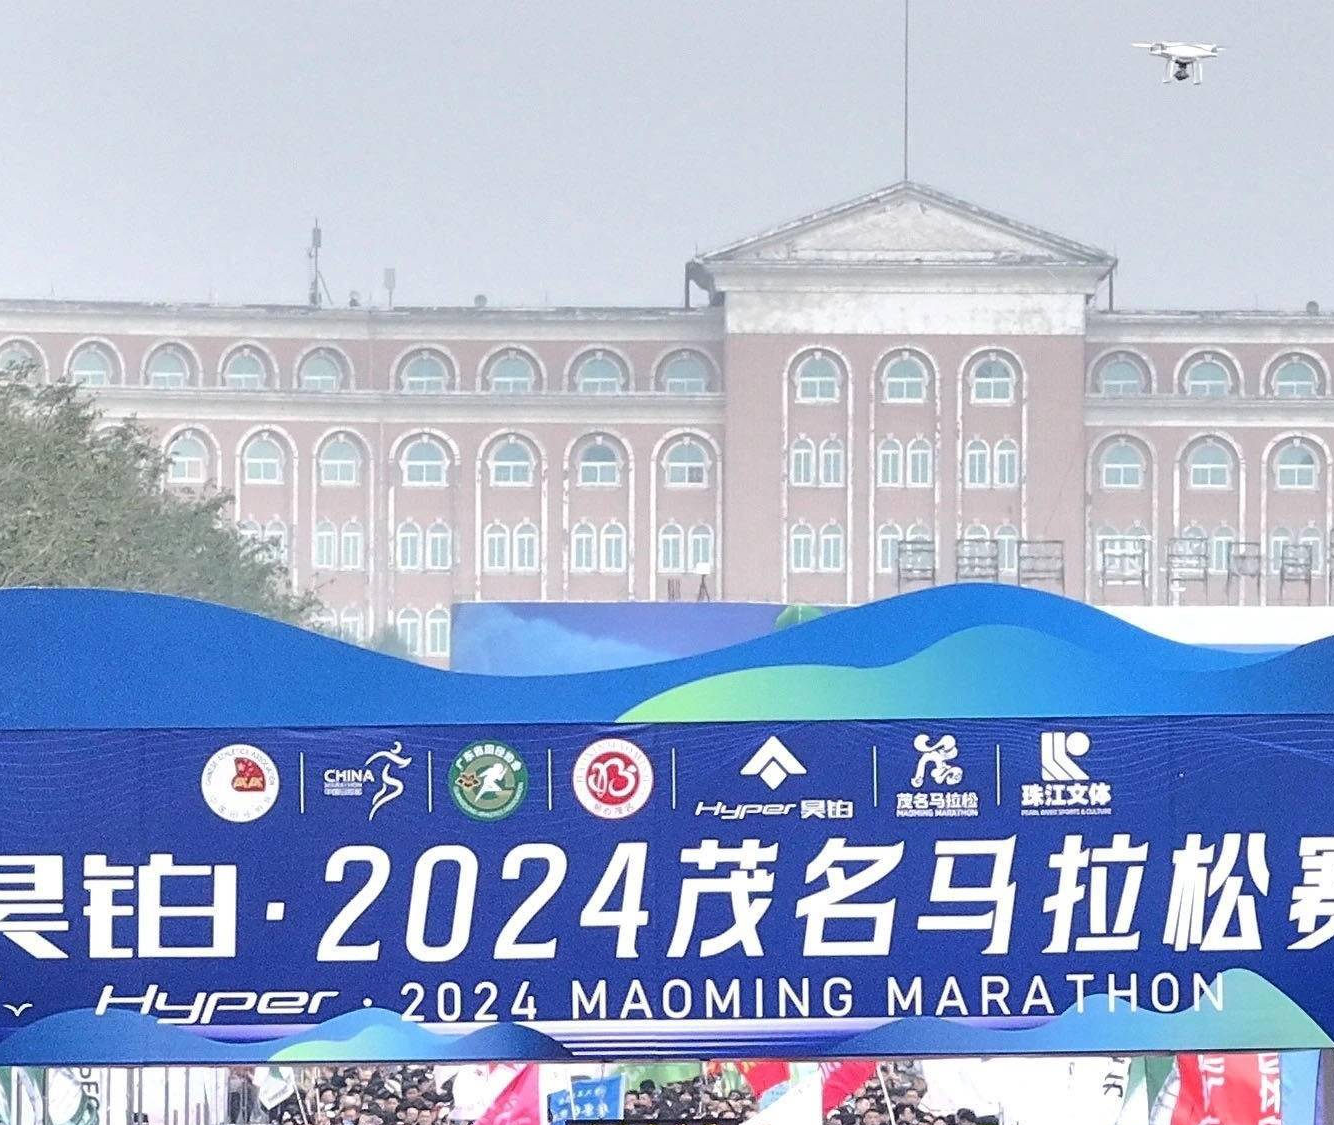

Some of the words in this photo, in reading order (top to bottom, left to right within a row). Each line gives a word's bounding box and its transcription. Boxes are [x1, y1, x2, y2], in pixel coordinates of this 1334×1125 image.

[323, 769, 375, 783] CHINA
[896, 792, 979, 809] 茂名马拉松
[1021, 783, 1112, 806] 珠江文体
[695, 801, 797, 820] Hyper
[801, 799, 854, 820] 昊铂
[934, 809, 979, 817] MARATHON
[95, 984, 338, 1025] Hyper
[400, 980, 538, 1024] 2024
[571, 976, 854, 1020] MAOMING
[887, 970, 1225, 1016] MARATHON
